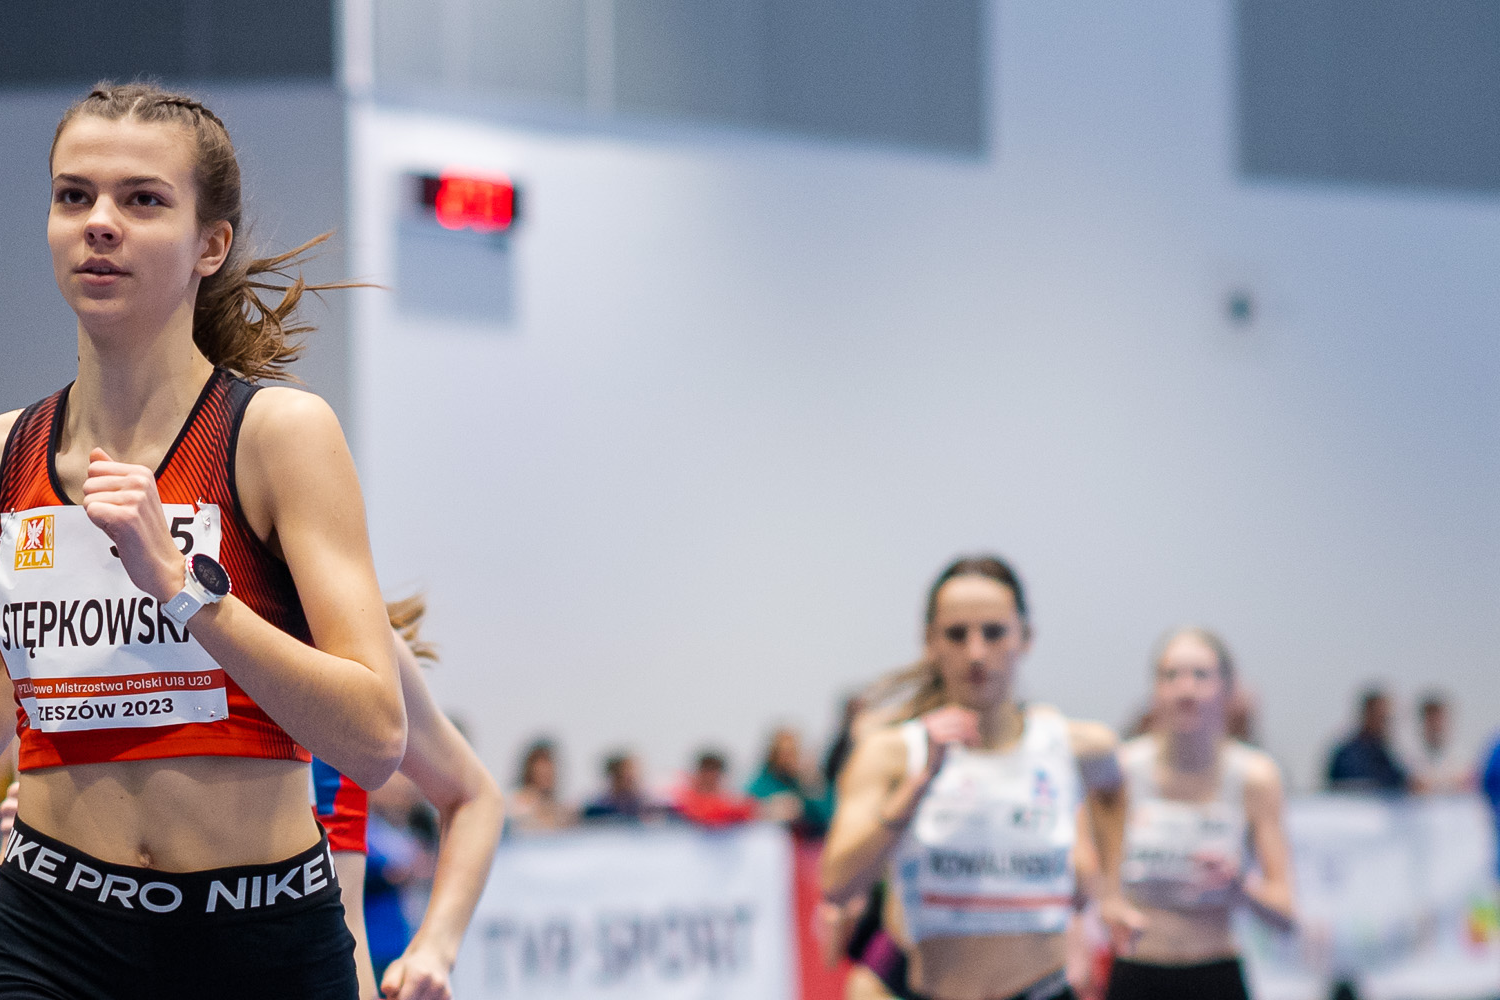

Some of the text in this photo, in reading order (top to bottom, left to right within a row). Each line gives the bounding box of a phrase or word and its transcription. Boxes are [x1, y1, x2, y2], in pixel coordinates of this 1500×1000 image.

[16, 551, 51, 568] PZLA
[2, 597, 190, 659] STĘPKOWSK
[55, 681, 123, 694] Mistrzostwa
[126, 676, 162, 690] Polski
[165, 676, 186, 687] U18
[188, 675, 212, 686] U20
[122, 698, 174, 718] 2023
[4, 826, 67, 885] IKE
[65, 861, 183, 914] PRO
[205, 853, 328, 913] NIKE
